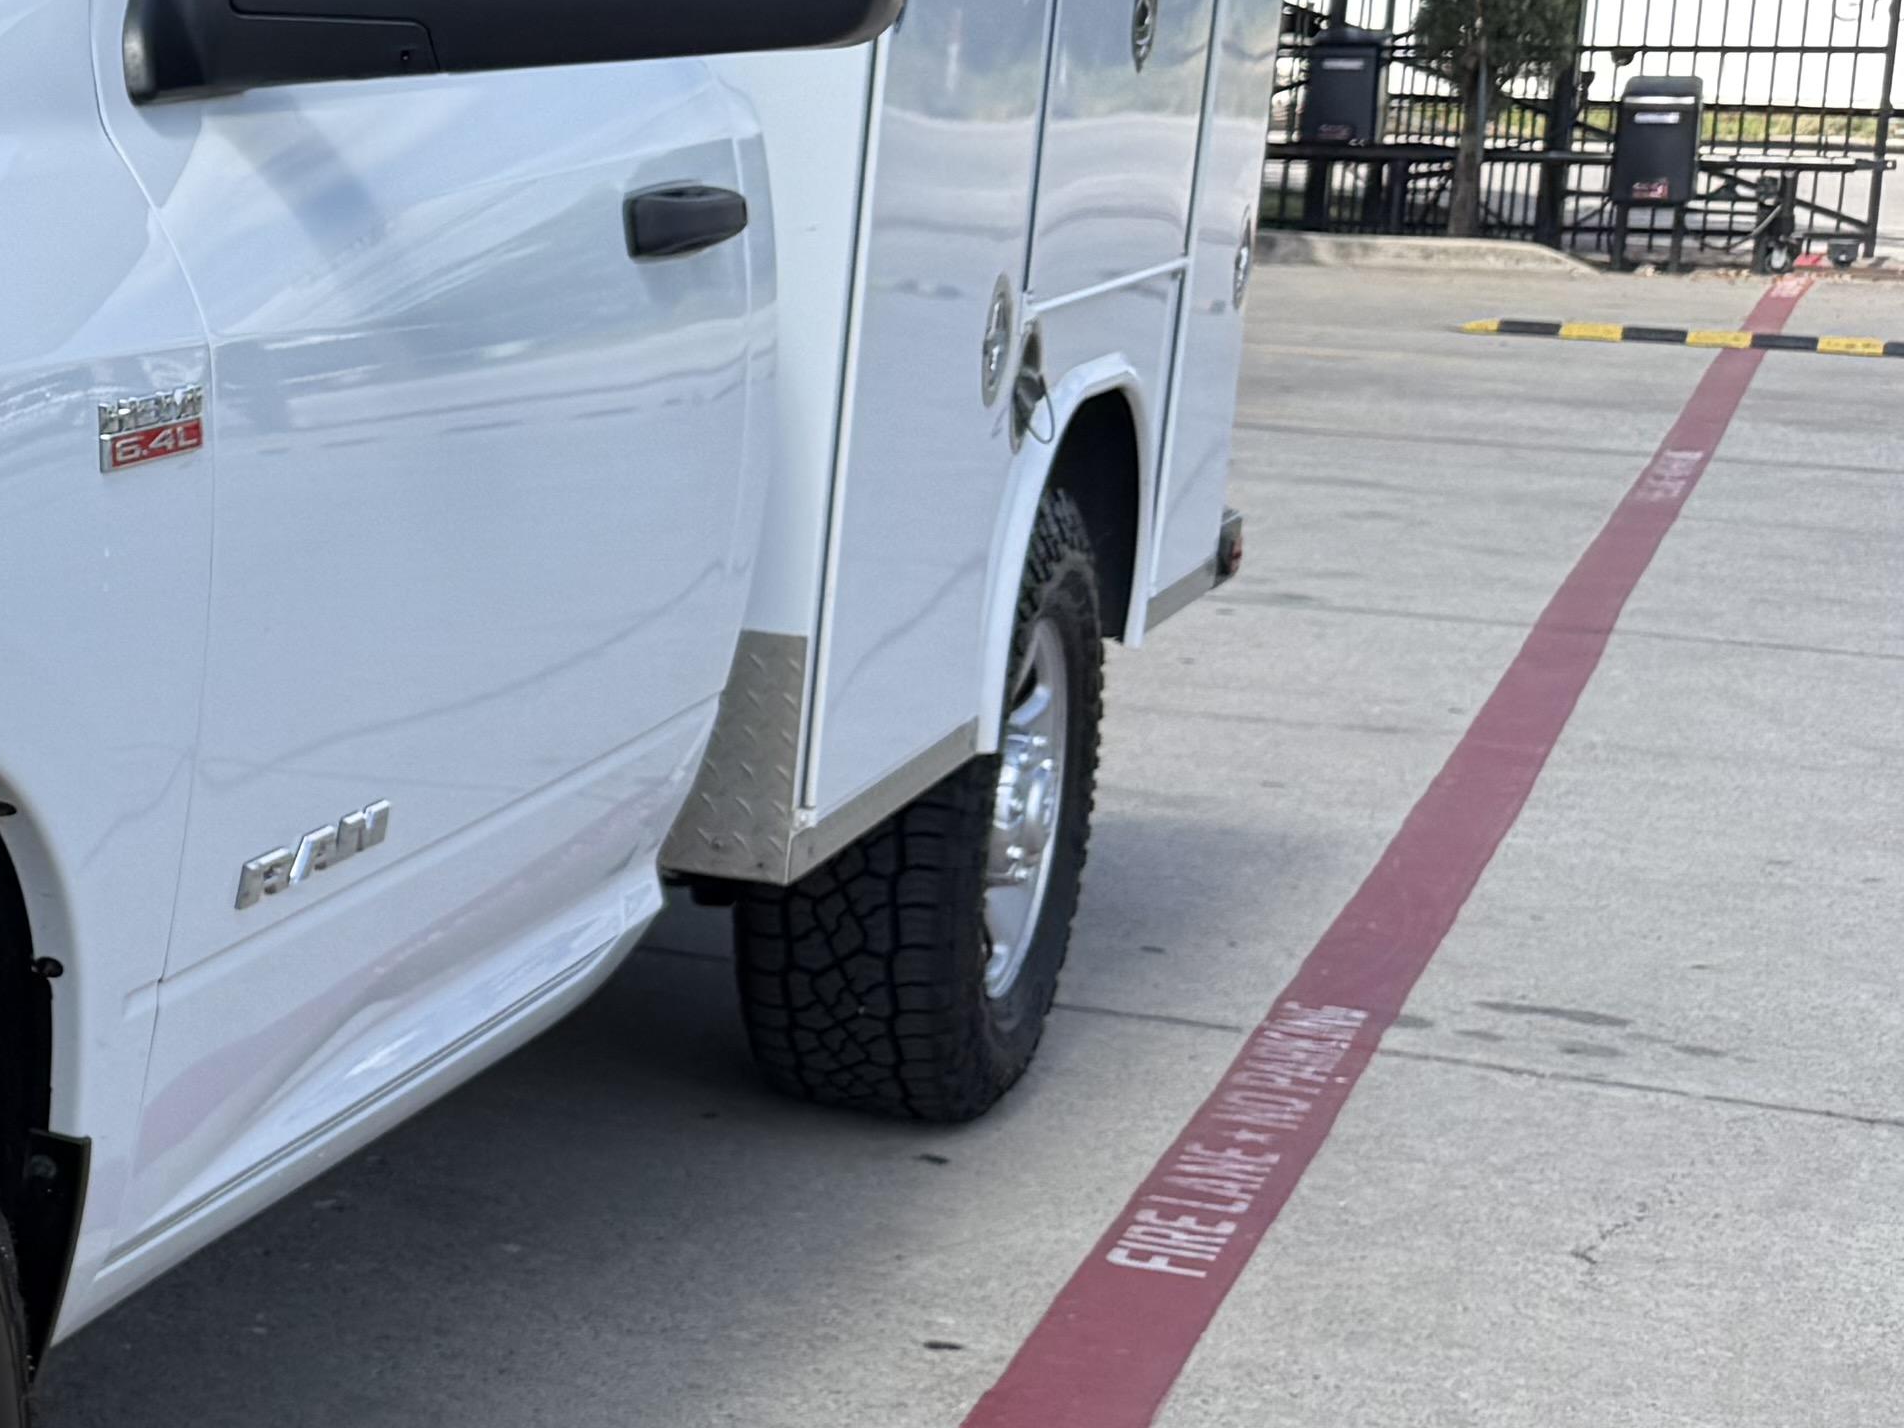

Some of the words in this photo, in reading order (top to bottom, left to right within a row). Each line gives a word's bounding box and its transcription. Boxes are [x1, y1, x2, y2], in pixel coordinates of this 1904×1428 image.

[114, 425, 198, 462] 6.4L
[234, 798, 391, 910] RAM
[1142, 1143, 1280, 1213] LANE
[1106, 1208, 1236, 1278] FIRE
